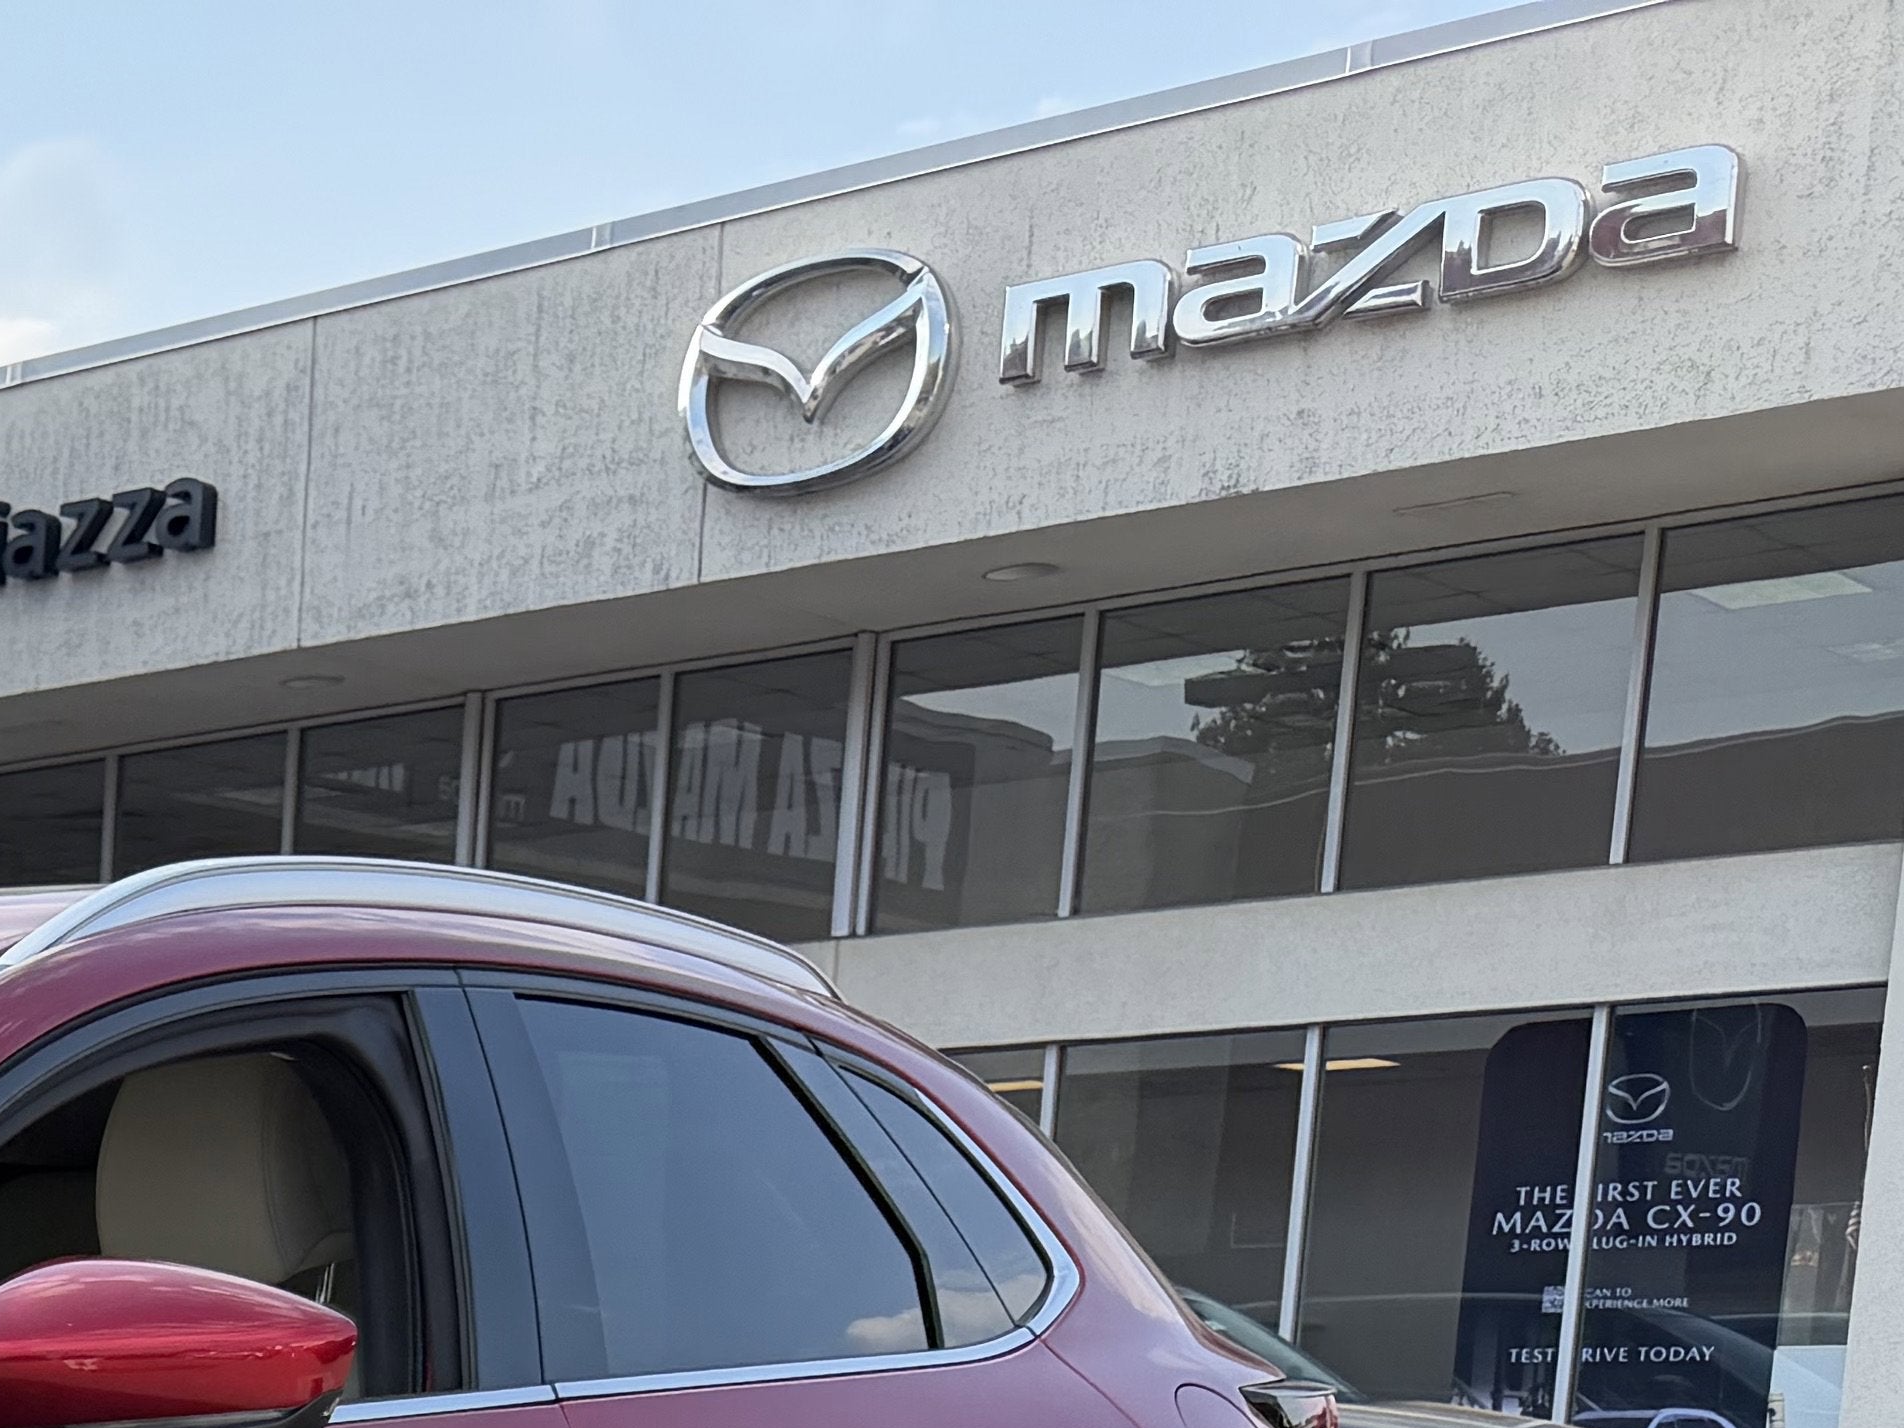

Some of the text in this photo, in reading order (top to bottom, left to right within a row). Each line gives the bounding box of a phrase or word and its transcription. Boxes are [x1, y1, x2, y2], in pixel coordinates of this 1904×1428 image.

[998, 142, 1744, 387] mazda
[1516, 1177, 1743, 1206] THE IRST EVER
[1646, 1201, 1762, 1230] CX-90
[1510, 1231, 1738, 1253] 3-ROW LUG-IN HYBRID
[1585, 1287, 1611, 1298] CAN
[1509, 1345, 1715, 1364] TEST RIVE TODAY
